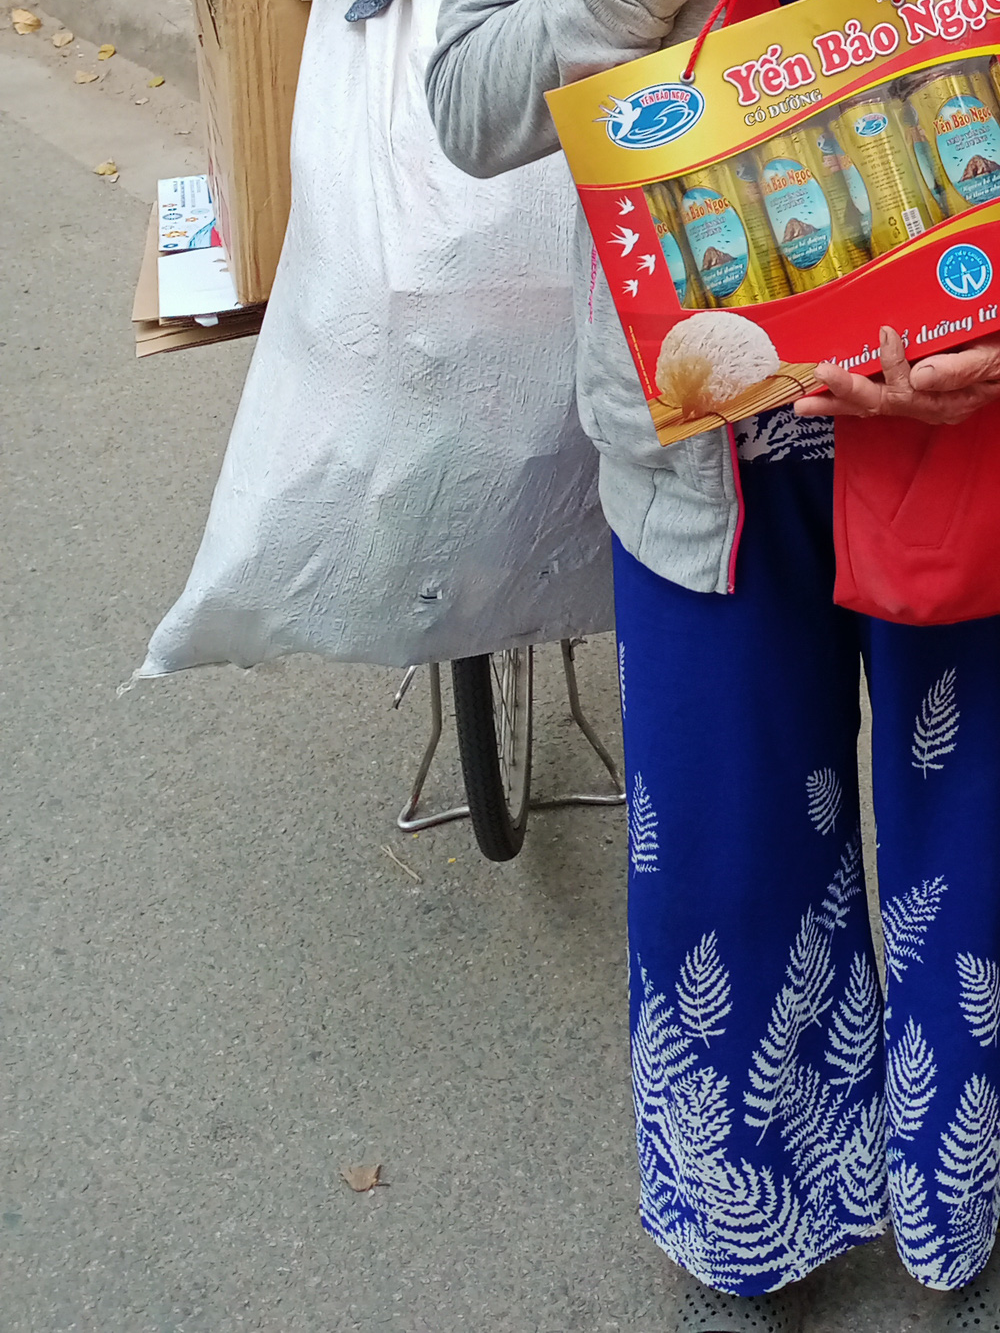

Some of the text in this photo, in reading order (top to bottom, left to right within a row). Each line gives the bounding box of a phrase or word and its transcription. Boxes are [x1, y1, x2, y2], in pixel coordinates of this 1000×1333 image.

[724, 44, 816, 106] Yến
[813, 19, 899, 76] Bảo
[744, 106, 766, 126] CÓ
[978, 303, 998, 324] từ
